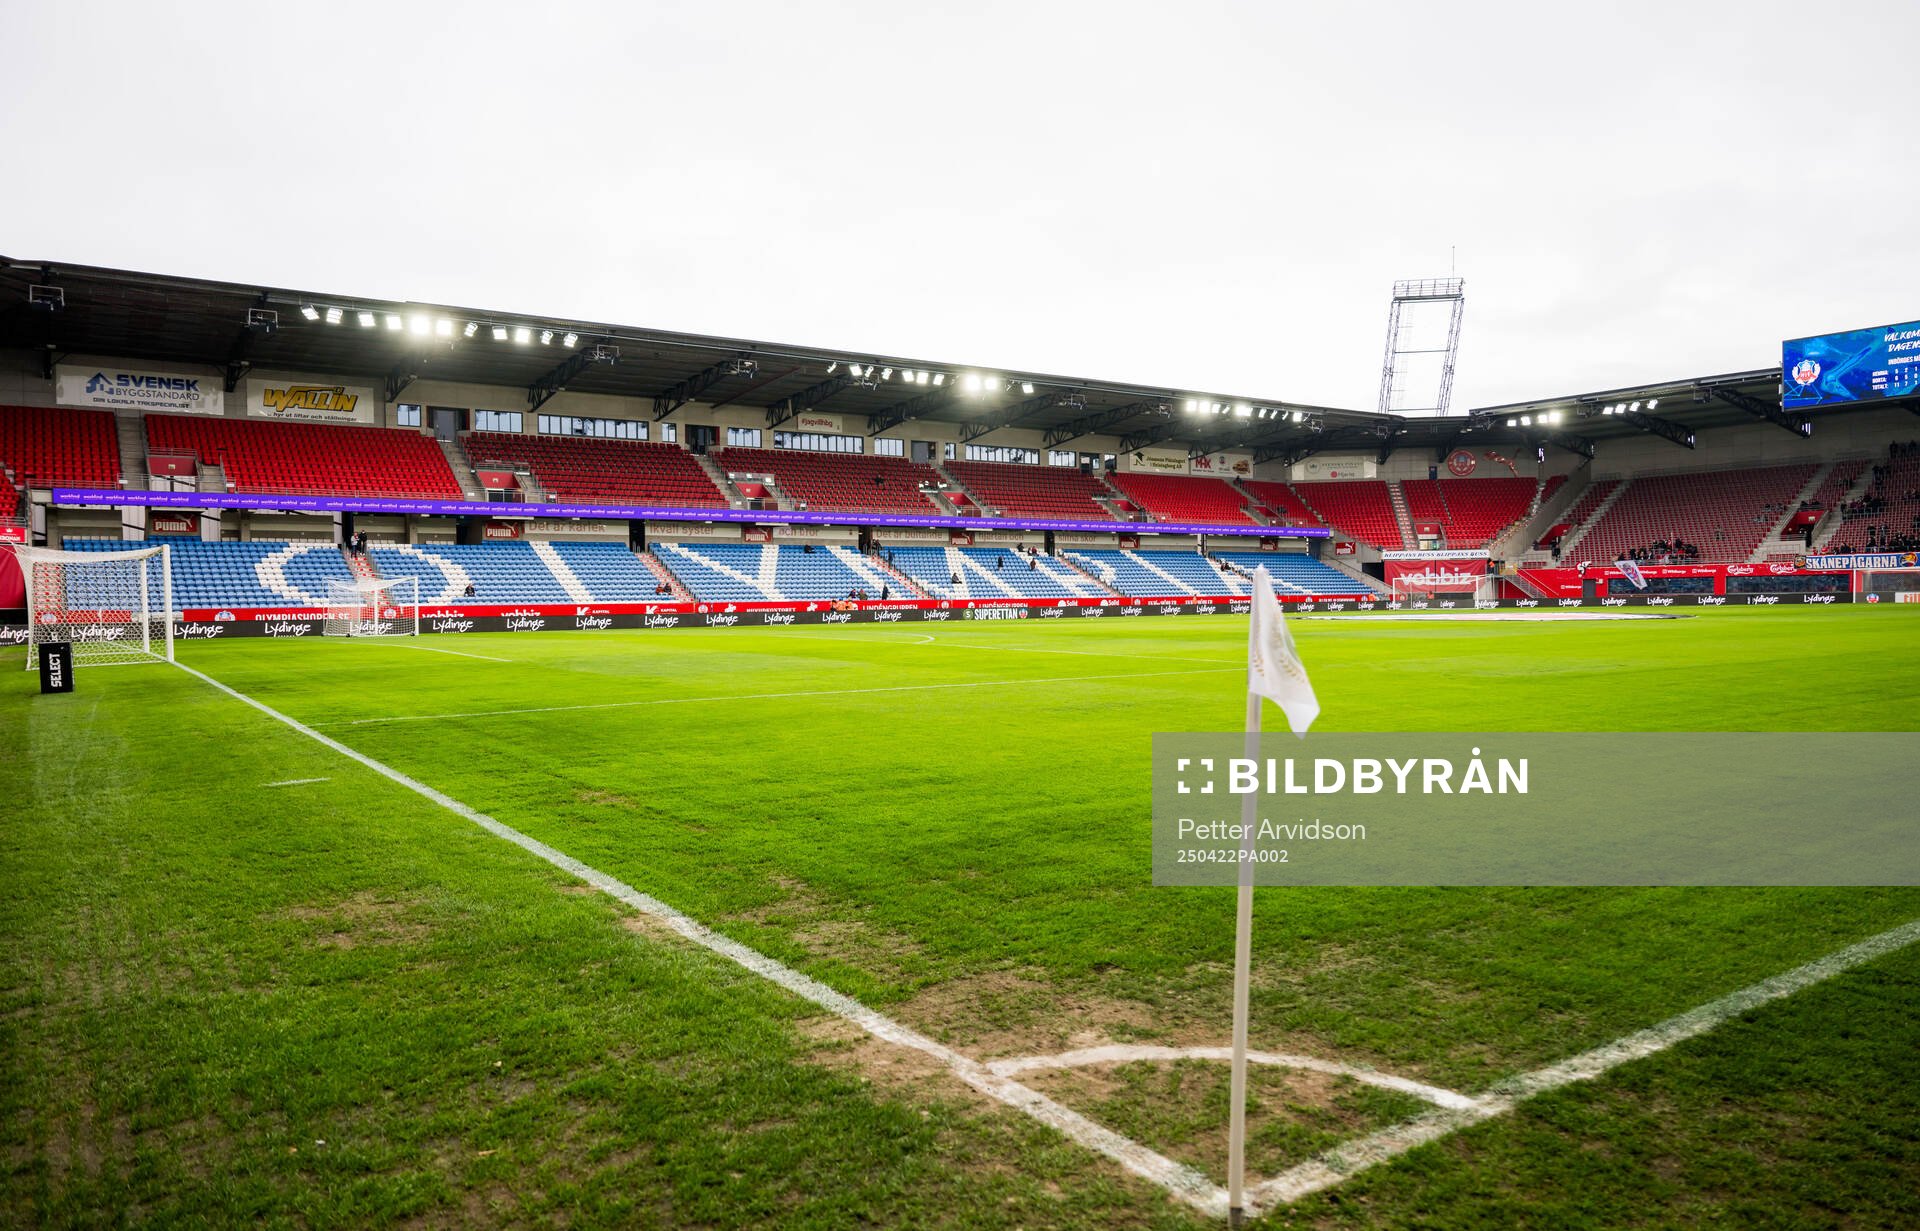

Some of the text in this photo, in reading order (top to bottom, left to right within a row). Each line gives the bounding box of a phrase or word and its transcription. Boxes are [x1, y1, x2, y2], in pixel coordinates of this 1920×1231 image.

[117, 374, 199, 391] SVENSK
[115, 388, 199, 401] BYGGSTANDARD
[263, 386, 358, 412] WALLIN
[137, 400, 190, 409] TAKSPECIALIST
[155, 521, 187, 531] PUMA
[487, 528, 512, 537] PUMA
[746, 533, 765, 541] PUMA
[1400, 567, 1472, 585] vebbiz
[1727, 565, 1754, 575] Carlsberg
[1698, 596, 1726, 606] Lydinge
[1803, 594, 1836, 605] Lydinge
[645, 612, 679, 629] Lydinge
[706, 613, 739, 627] Lydinge
[765, 612, 796, 626] Lydinge
[823, 612, 852, 624] Lydinge
[874, 611, 902, 623] Lydinge
[923, 610, 950, 622] Lydinge
[974, 608, 1018, 620] SUPERETTAN
[265, 621, 311, 637] Lydinge
[433, 617, 474, 633] Lydinge
[506, 615, 545, 632] Lydinge
[576, 614, 612, 631] Lydinge
[173, 621, 224, 639] Lydinge
[49, 653, 62, 687] SELECT
